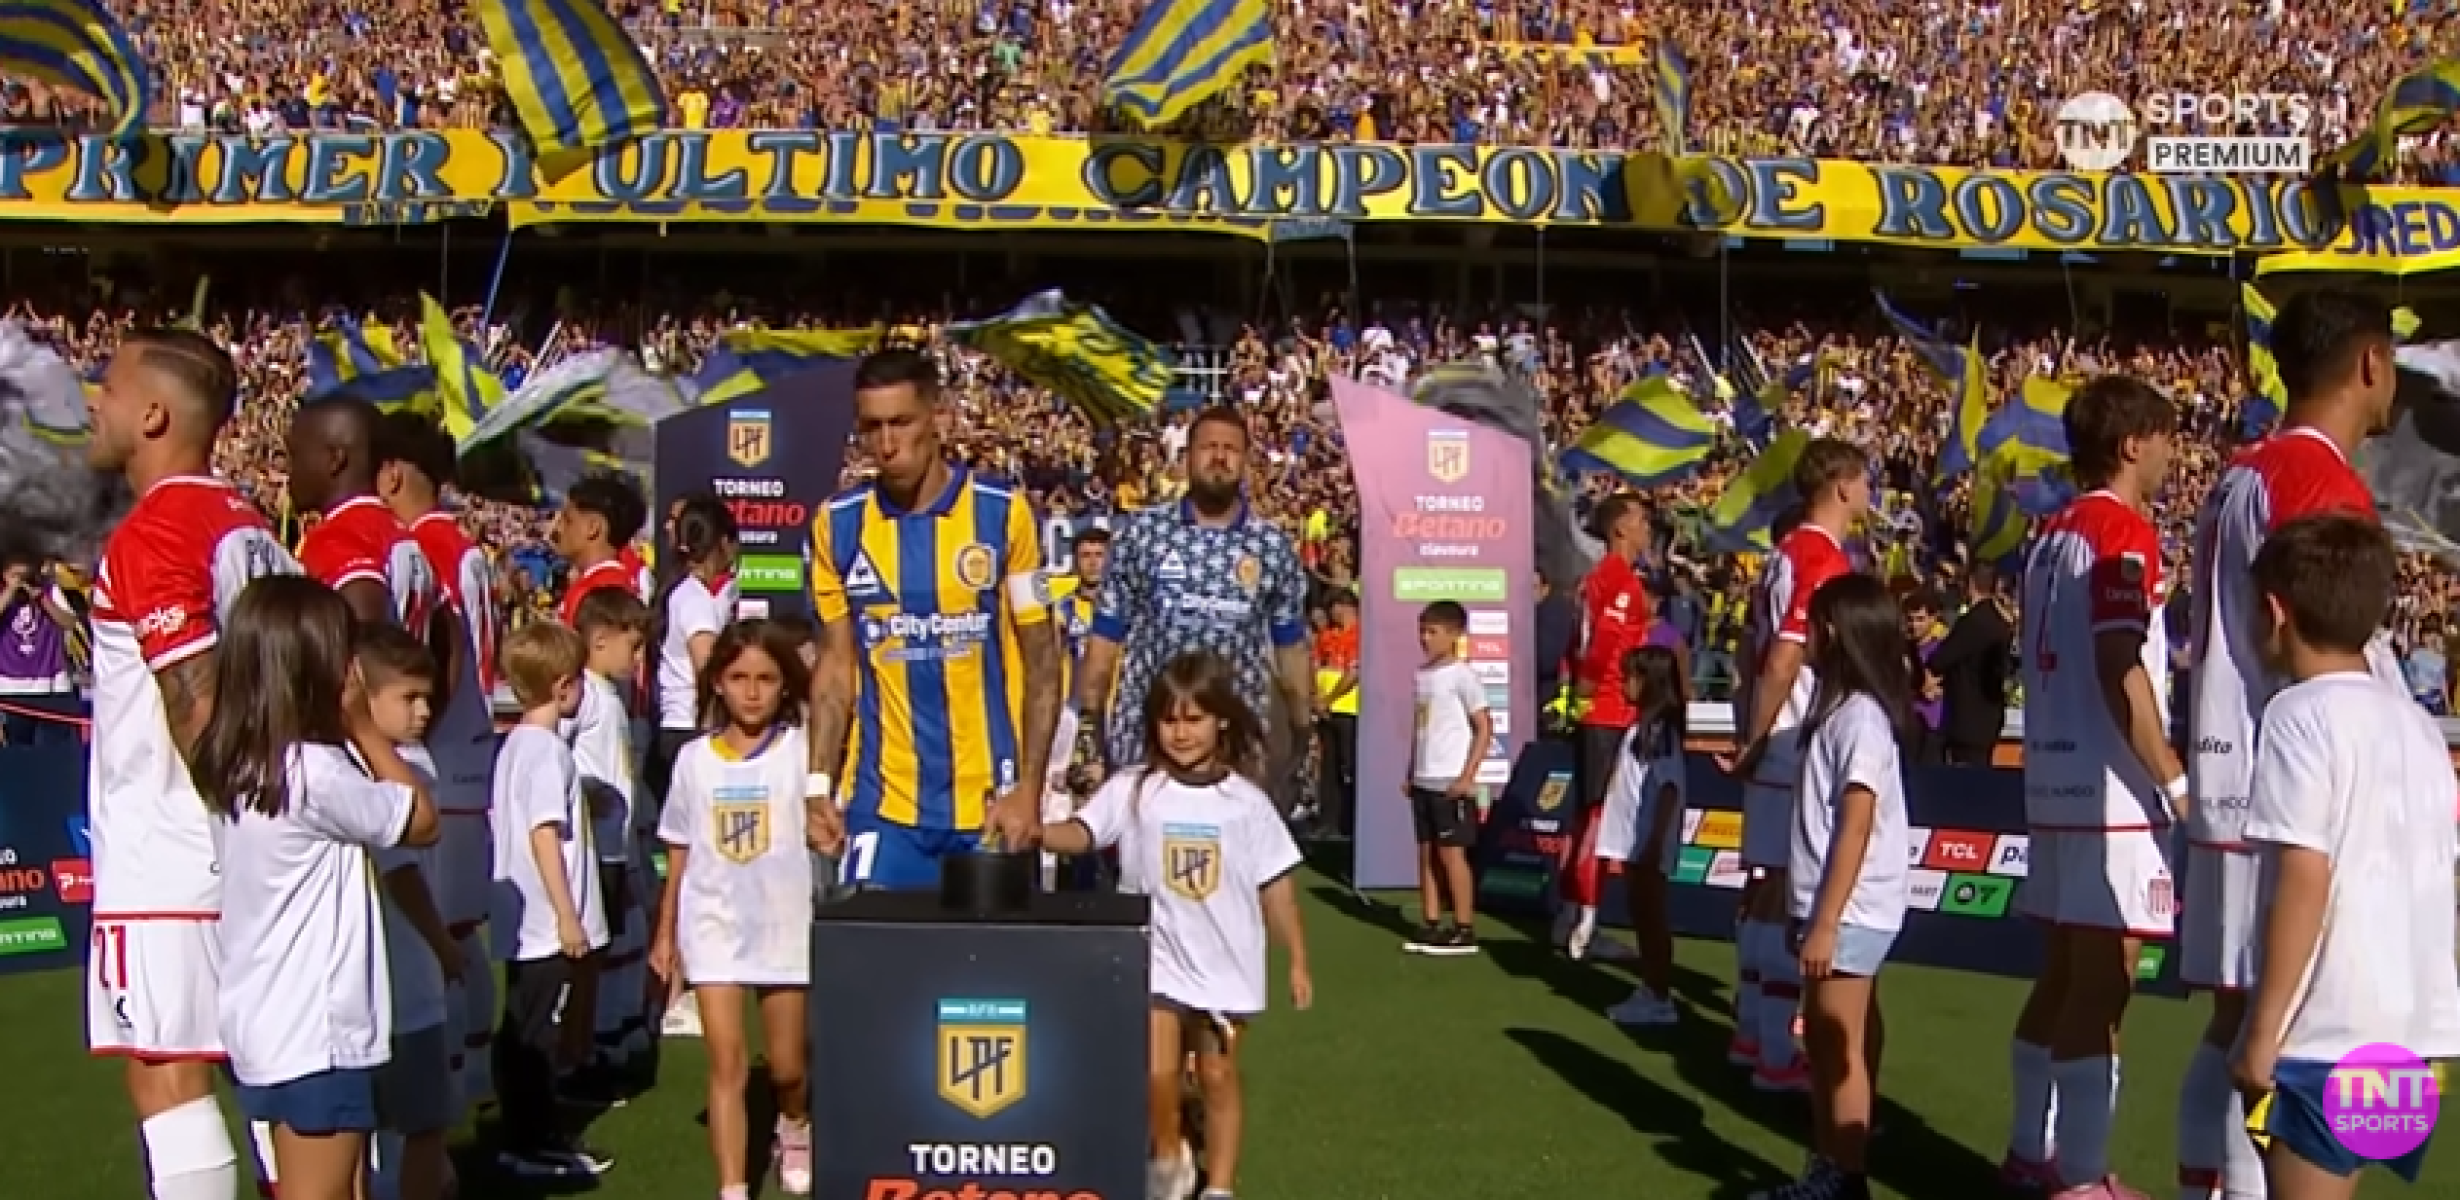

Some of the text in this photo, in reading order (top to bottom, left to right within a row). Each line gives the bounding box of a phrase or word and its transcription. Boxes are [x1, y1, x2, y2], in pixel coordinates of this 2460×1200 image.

[0, 130, 450, 201] PRIMER
[1080, 142, 1634, 224] CAMPEON
[1684, 156, 1823, 229] DE
[1871, 166, 2345, 249] ROSARIO
[713, 478, 785, 497] TORNEO
[1414, 496, 1484, 511] TORNEO
[1940, 841, 1979, 860] TCL
[950, 1035, 1014, 1101] LPF
[909, 1144, 1056, 1174] TORNEO
